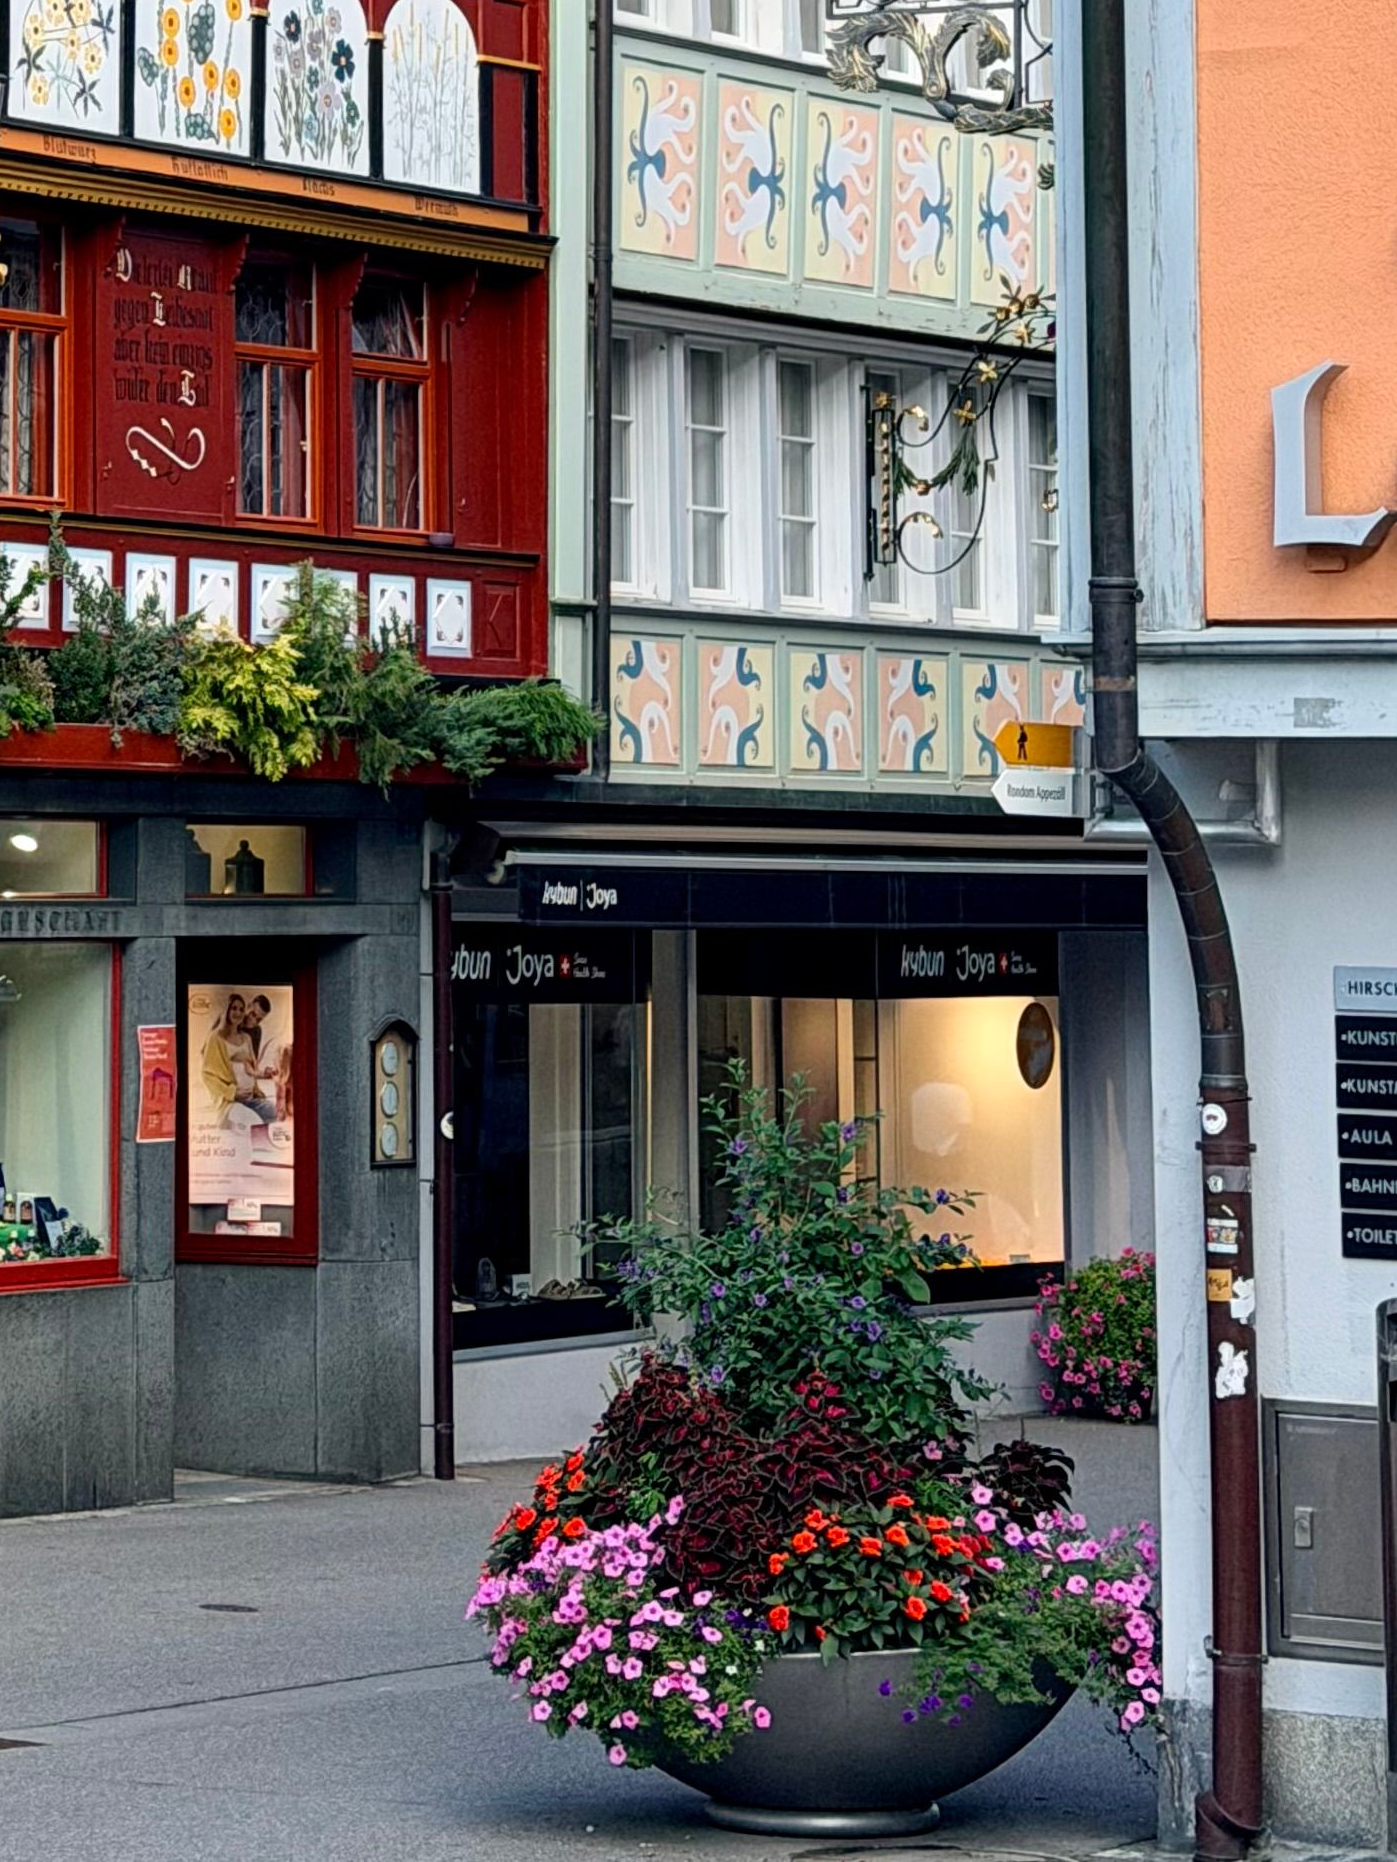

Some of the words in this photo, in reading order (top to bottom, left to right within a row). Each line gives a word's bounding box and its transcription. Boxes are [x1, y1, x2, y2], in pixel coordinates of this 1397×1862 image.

[542, 880, 578, 905] kybun
[586, 882, 618, 910] Joya
[506, 945, 554, 986] Joya
[900, 944, 945, 977] kybun
[956, 945, 995, 982] Joya
[1348, 980, 1397, 996] HIRSC
[1347, 1030, 1397, 1046] KUNST
[1350, 1128, 1393, 1146] AULA
[1351, 1178, 1397, 1194] BAHN
